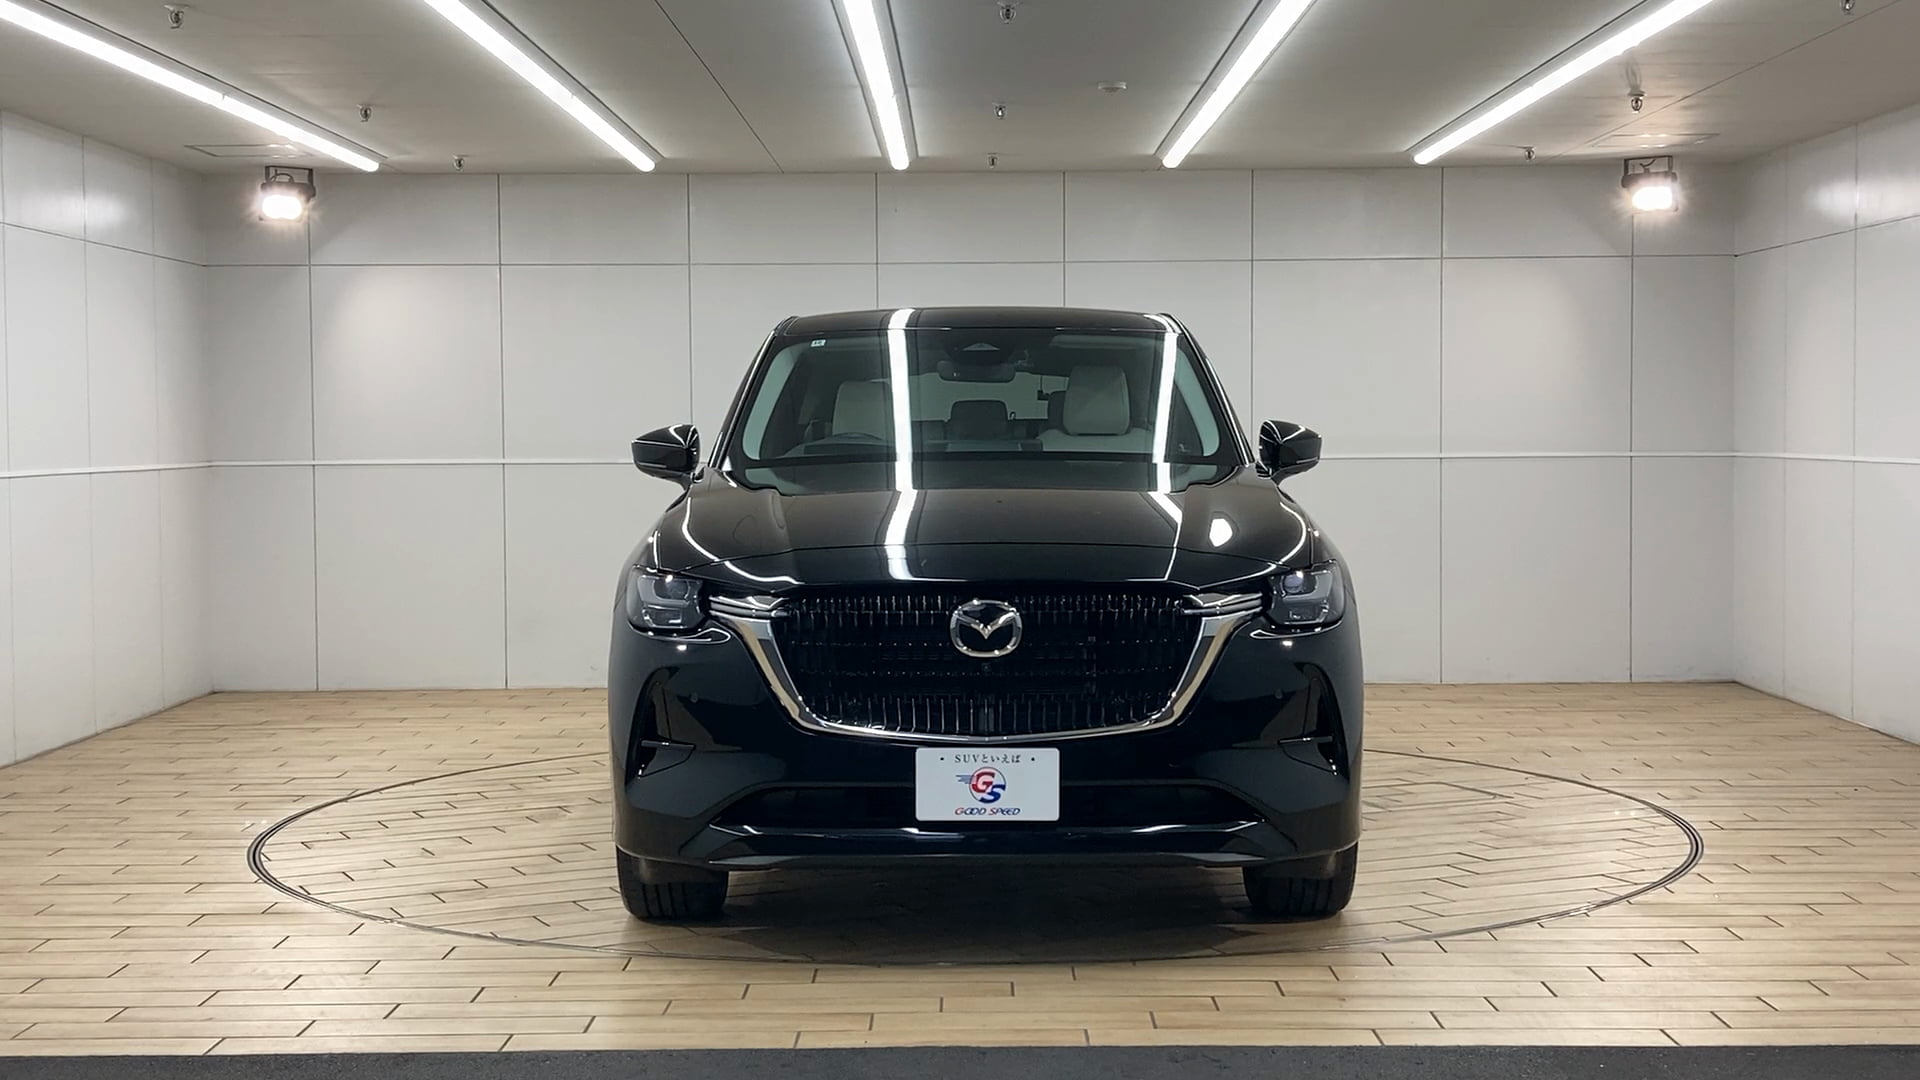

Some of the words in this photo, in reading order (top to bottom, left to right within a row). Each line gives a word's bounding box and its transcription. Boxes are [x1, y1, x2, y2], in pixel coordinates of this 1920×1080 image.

[954, 754, 1021, 764] SUVといえば
[955, 807, 987, 816] GOOD
[988, 807, 1021, 816] SPEED
